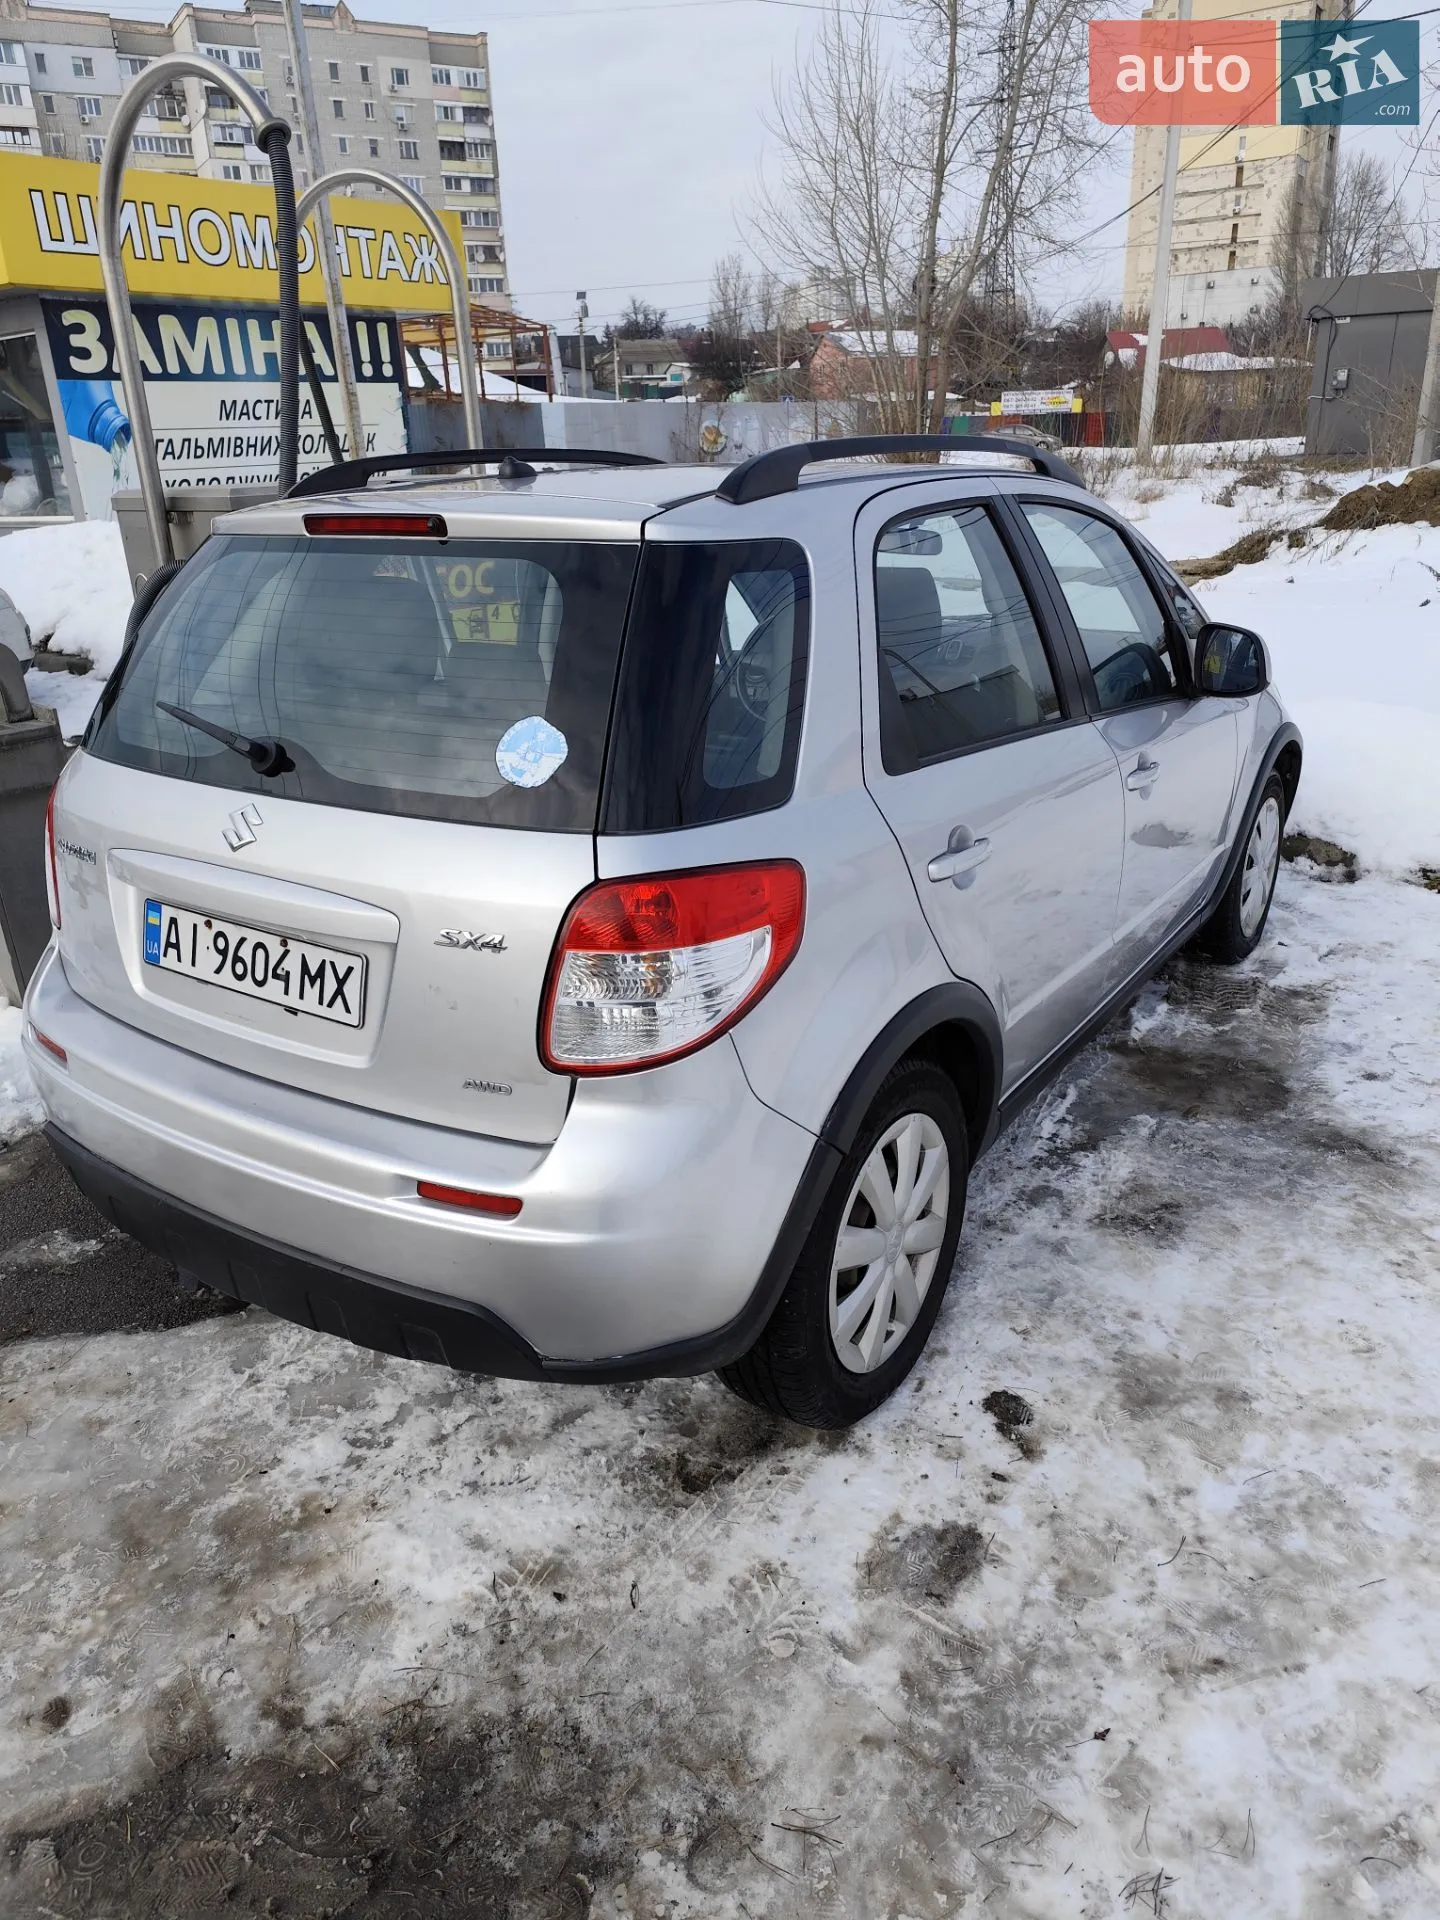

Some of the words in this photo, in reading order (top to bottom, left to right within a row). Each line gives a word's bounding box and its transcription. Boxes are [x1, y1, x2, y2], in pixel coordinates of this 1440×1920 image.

[218, 398, 313, 422] МАСТИА
[146, 939, 160, 956] UA
[433, 928, 508, 954] SX4
[462, 1077, 513, 1097] AWD
